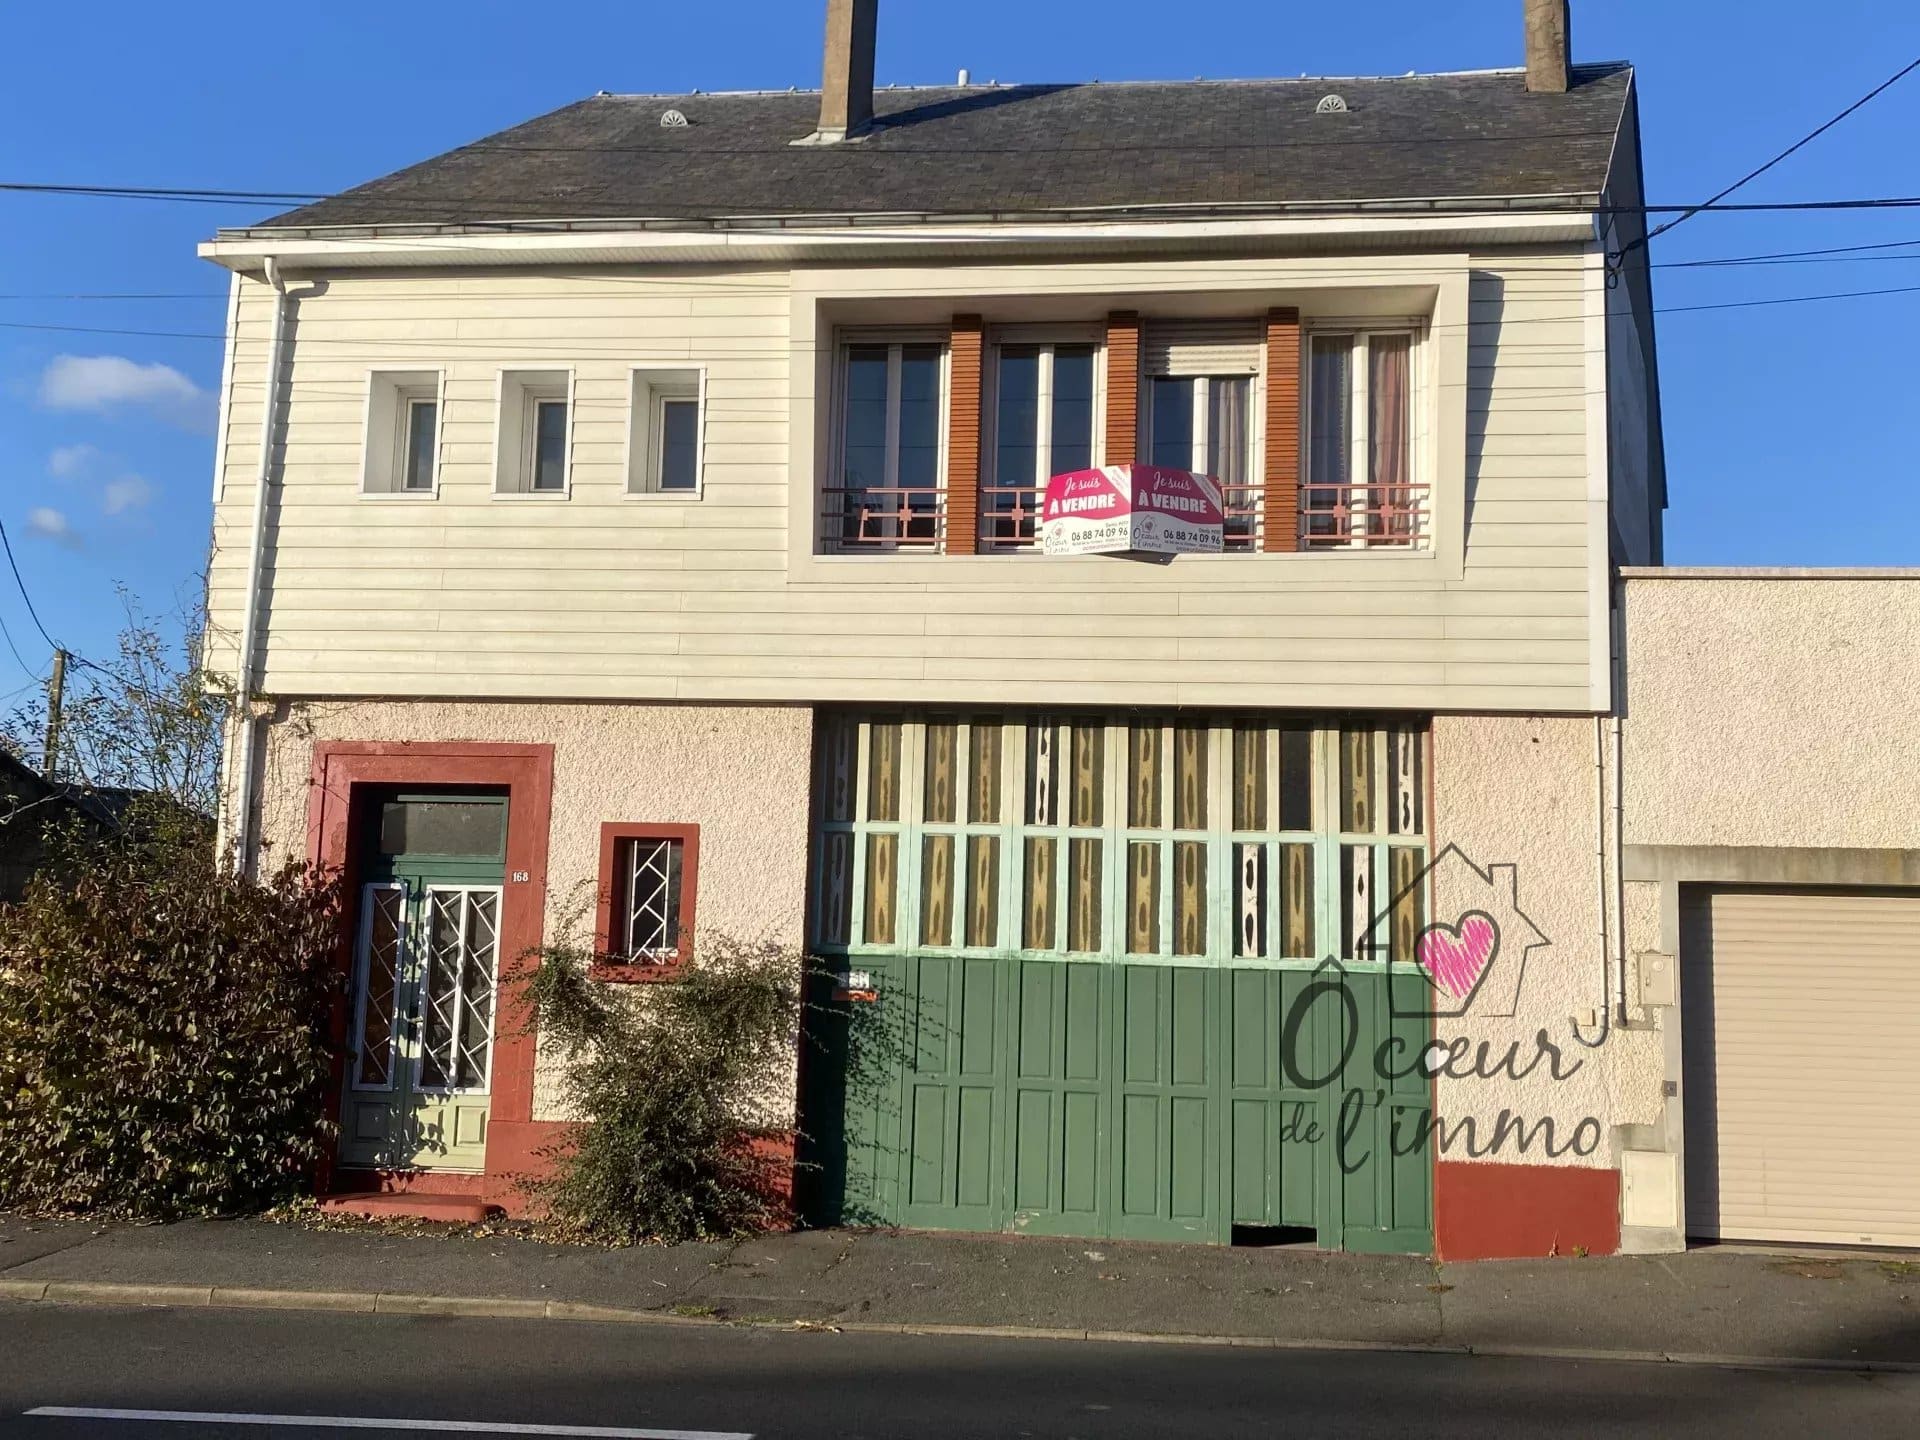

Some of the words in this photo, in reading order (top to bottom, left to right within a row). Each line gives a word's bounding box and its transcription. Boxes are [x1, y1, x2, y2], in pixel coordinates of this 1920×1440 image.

[1064, 477, 1077, 497] Je
[1078, 477, 1101, 490] suis
[1153, 472, 1167, 491] Je
[1168, 478, 1192, 491] suis
[1061, 493, 1116, 513] VENDRE
[1138, 489, 1149, 506] À
[1151, 493, 1208, 514] VENDRE
[1071, 532, 1081, 542] 06
[1082, 530, 1092, 540] 88
[1094, 528, 1104, 538] 74
[1106, 528, 1116, 538] 09
[1118, 527, 1128, 537] 96
[1163, 529, 1174, 539] 06
[1175, 530, 1186, 541] 88
[1188, 532, 1198, 541] 74
[1199, 533, 1209, 543] 09
[1211, 534, 1221, 545] 96
[512, 871, 529, 882] 168
